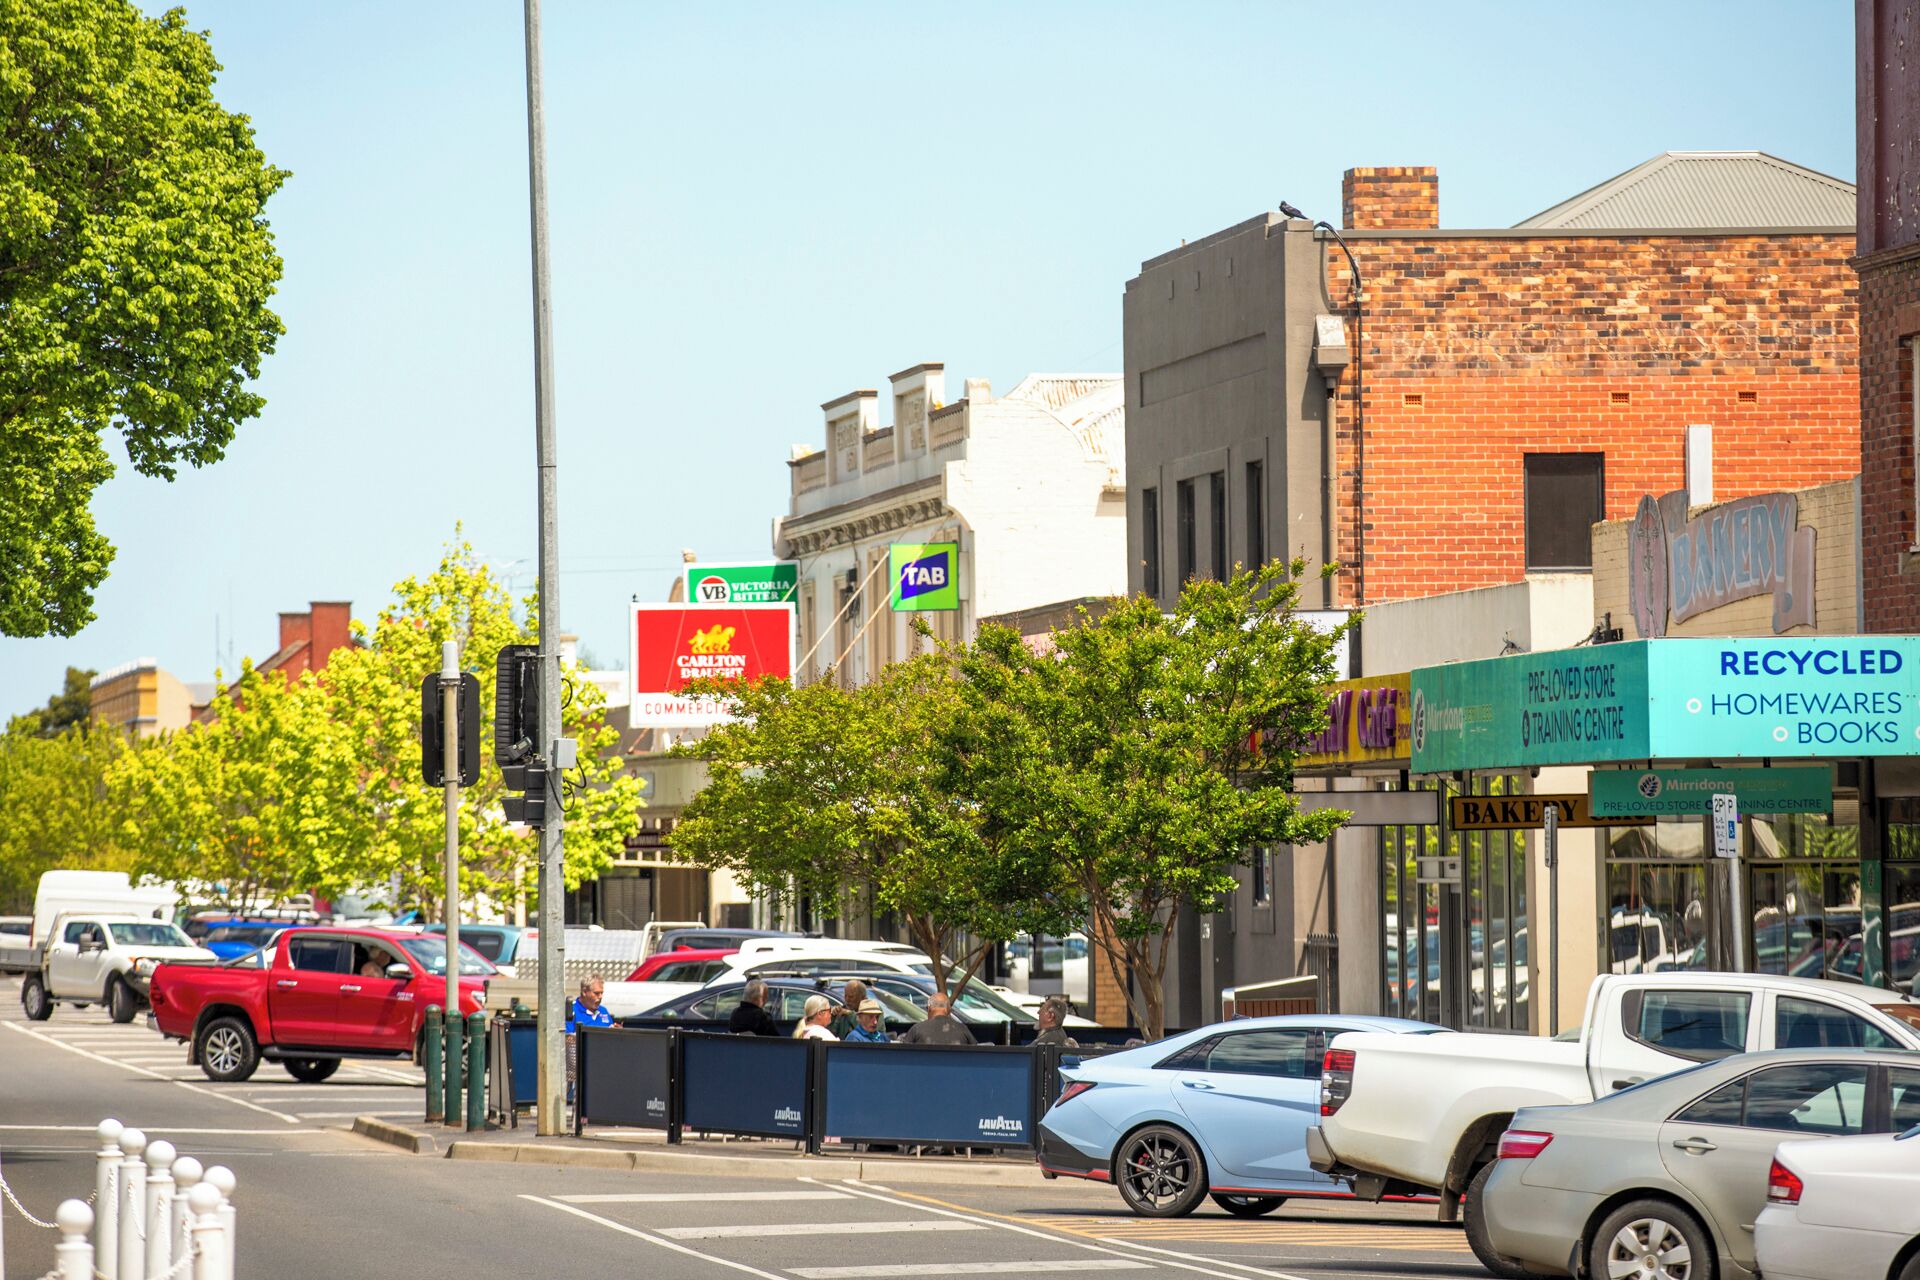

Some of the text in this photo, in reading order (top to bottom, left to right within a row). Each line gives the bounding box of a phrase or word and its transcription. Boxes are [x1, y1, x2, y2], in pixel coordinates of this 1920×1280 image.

[1672, 499, 1790, 616] BAKERY
[904, 567, 945, 585] TAB
[731, 580, 790, 591] VICTORIA
[702, 586, 727, 600] VB
[733, 591, 779, 602] BITTER
[677, 655, 746, 667] CARLTON
[1721, 650, 1903, 676] RECYCLED
[680, 667, 744, 679] DRAUGHT
[1528, 664, 1615, 704] PRE-LOVED STORE
[645, 702, 736, 715] COMMERCIA
[1711, 691, 1902, 715] HOMEWARES
[1532, 708, 1581, 744] TRAINING
[1585, 705, 1624, 741] CENTRE
[1798, 721, 1899, 743] BOOKS
[1666, 779, 1735, 793] Mirridong
[1603, 801, 1664, 812] PRE-LOVED
[1668, 800, 1701, 811] STORE
[1778, 798, 1822, 809] CENTRE
[1714, 799, 1724, 813] 2P
[774, 1107, 801, 1121] LAVAZZA
[978, 1115, 1023, 1131] LAVAZZA
